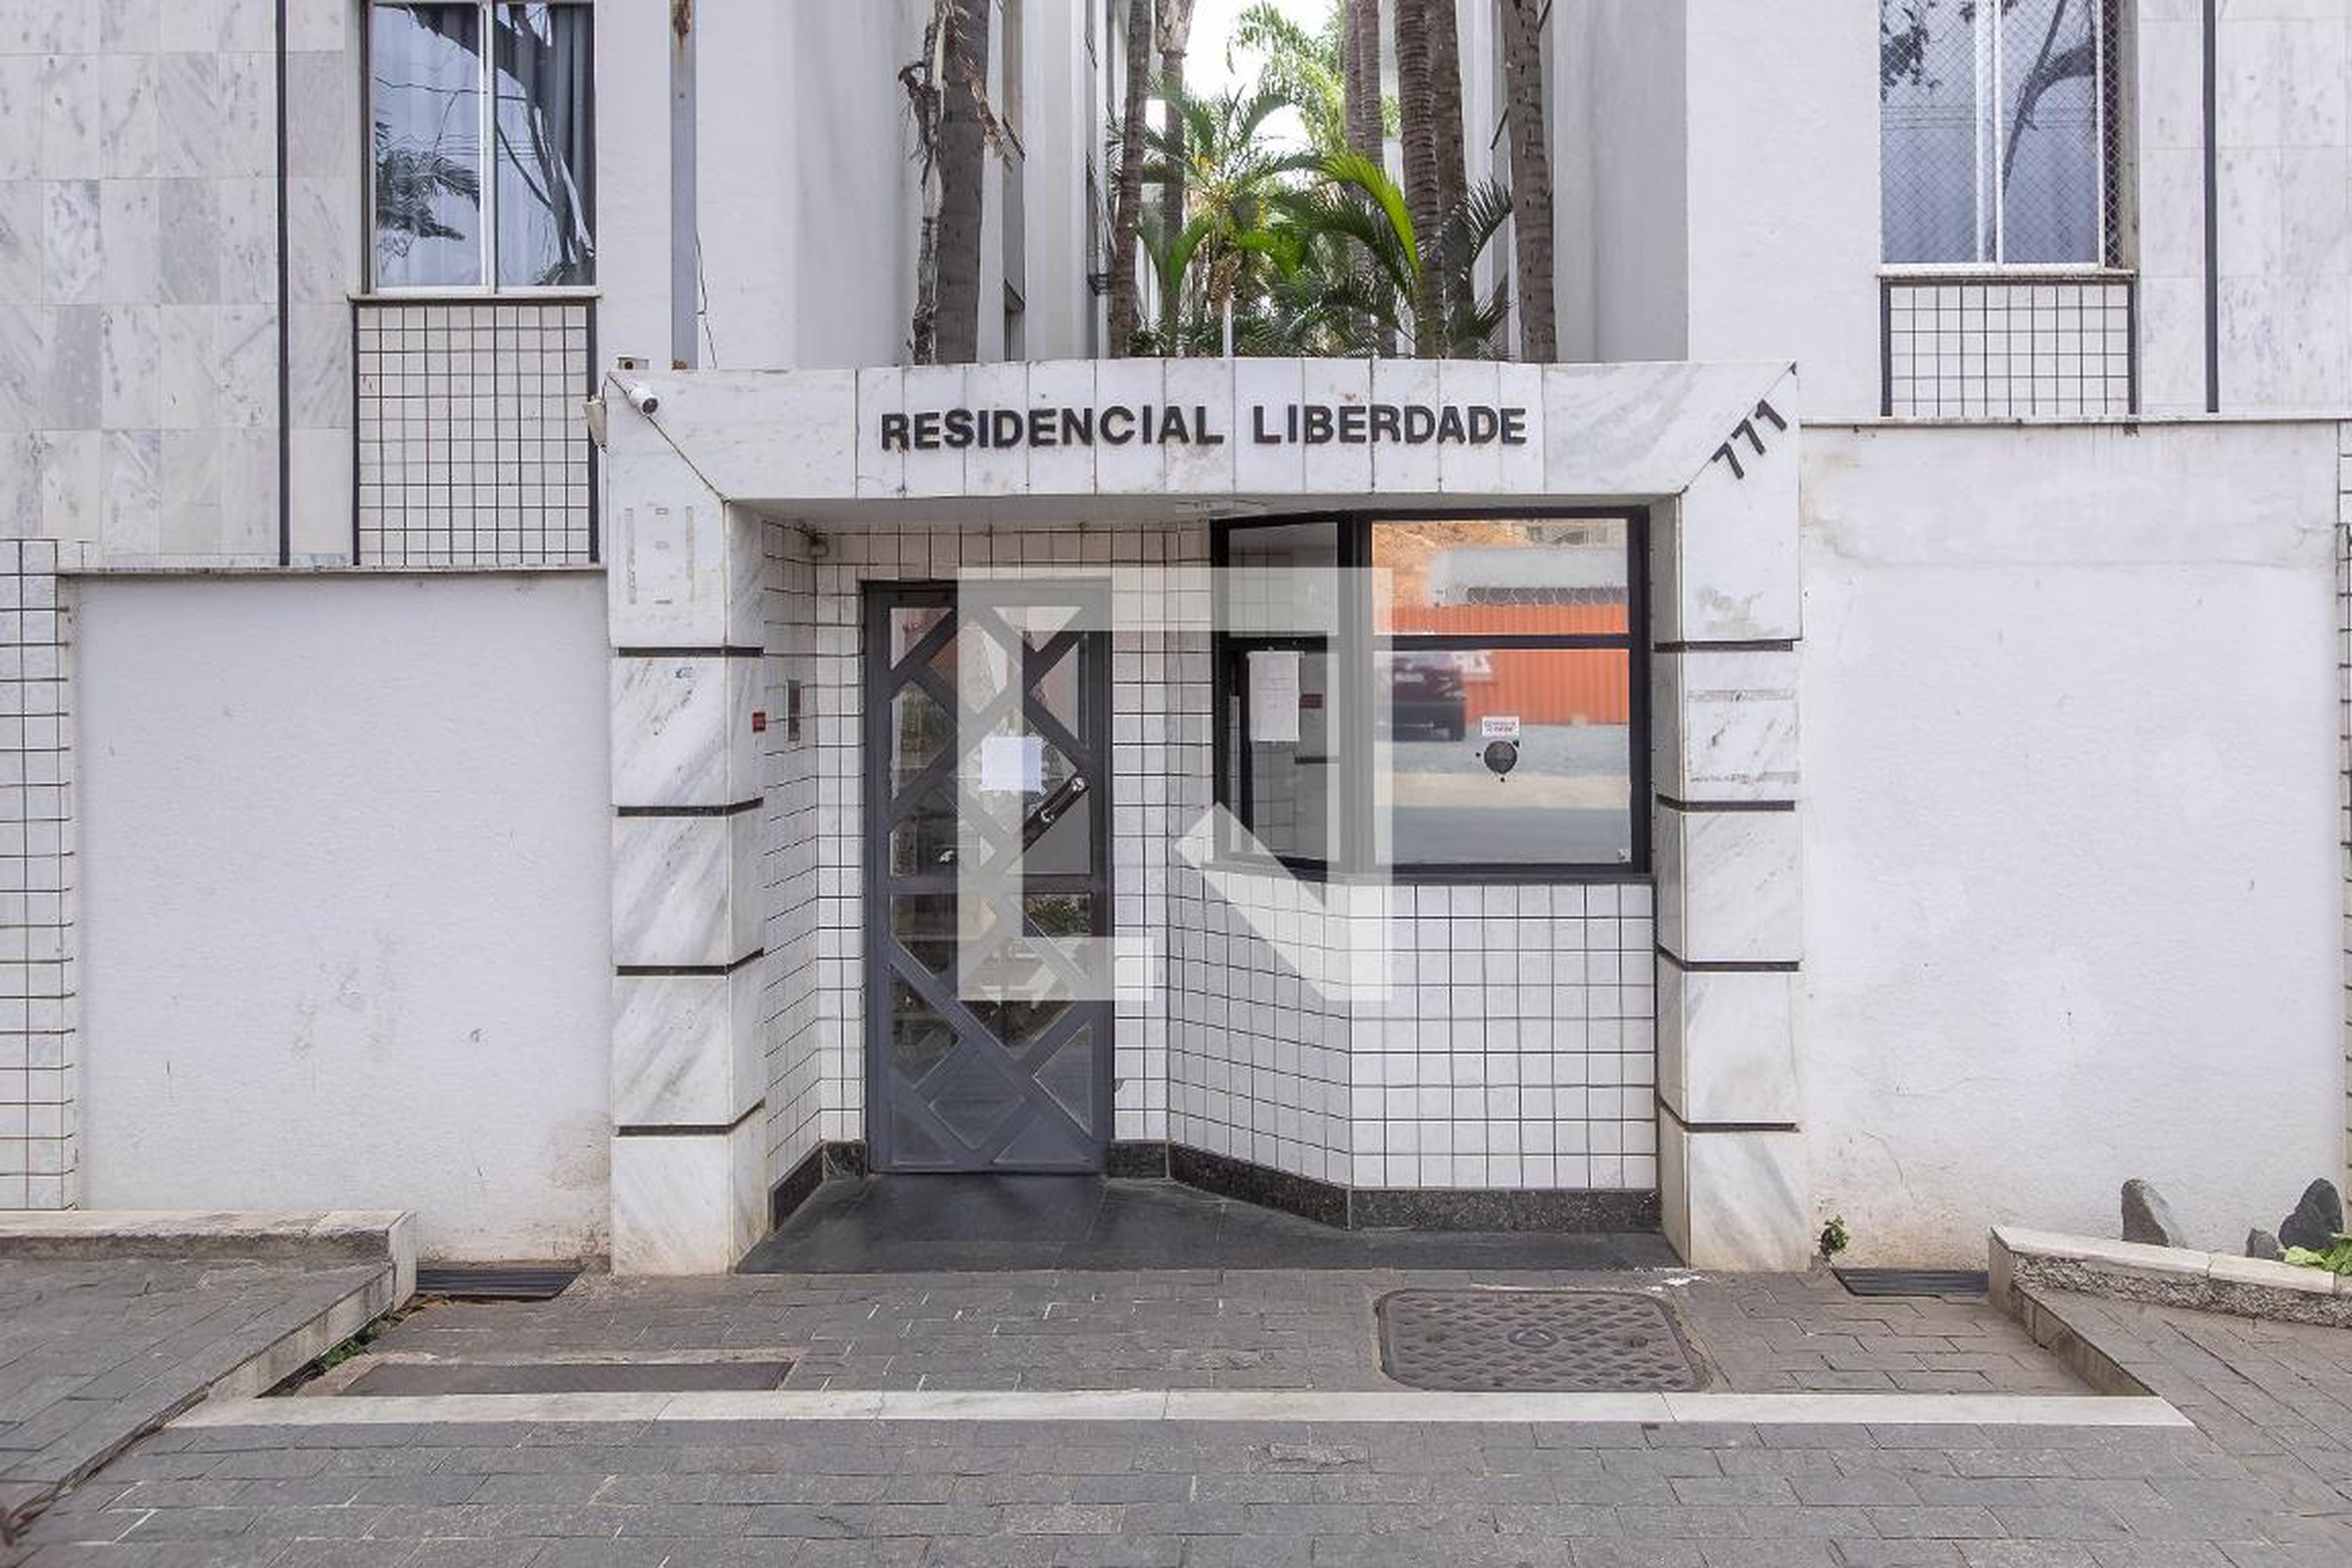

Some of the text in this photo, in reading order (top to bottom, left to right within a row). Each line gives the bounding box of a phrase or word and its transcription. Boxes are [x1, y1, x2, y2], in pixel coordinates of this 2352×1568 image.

[881, 404, 1528, 451] RESIDENCIAL LIBERDADE
[1711, 399, 1787, 480] 771
